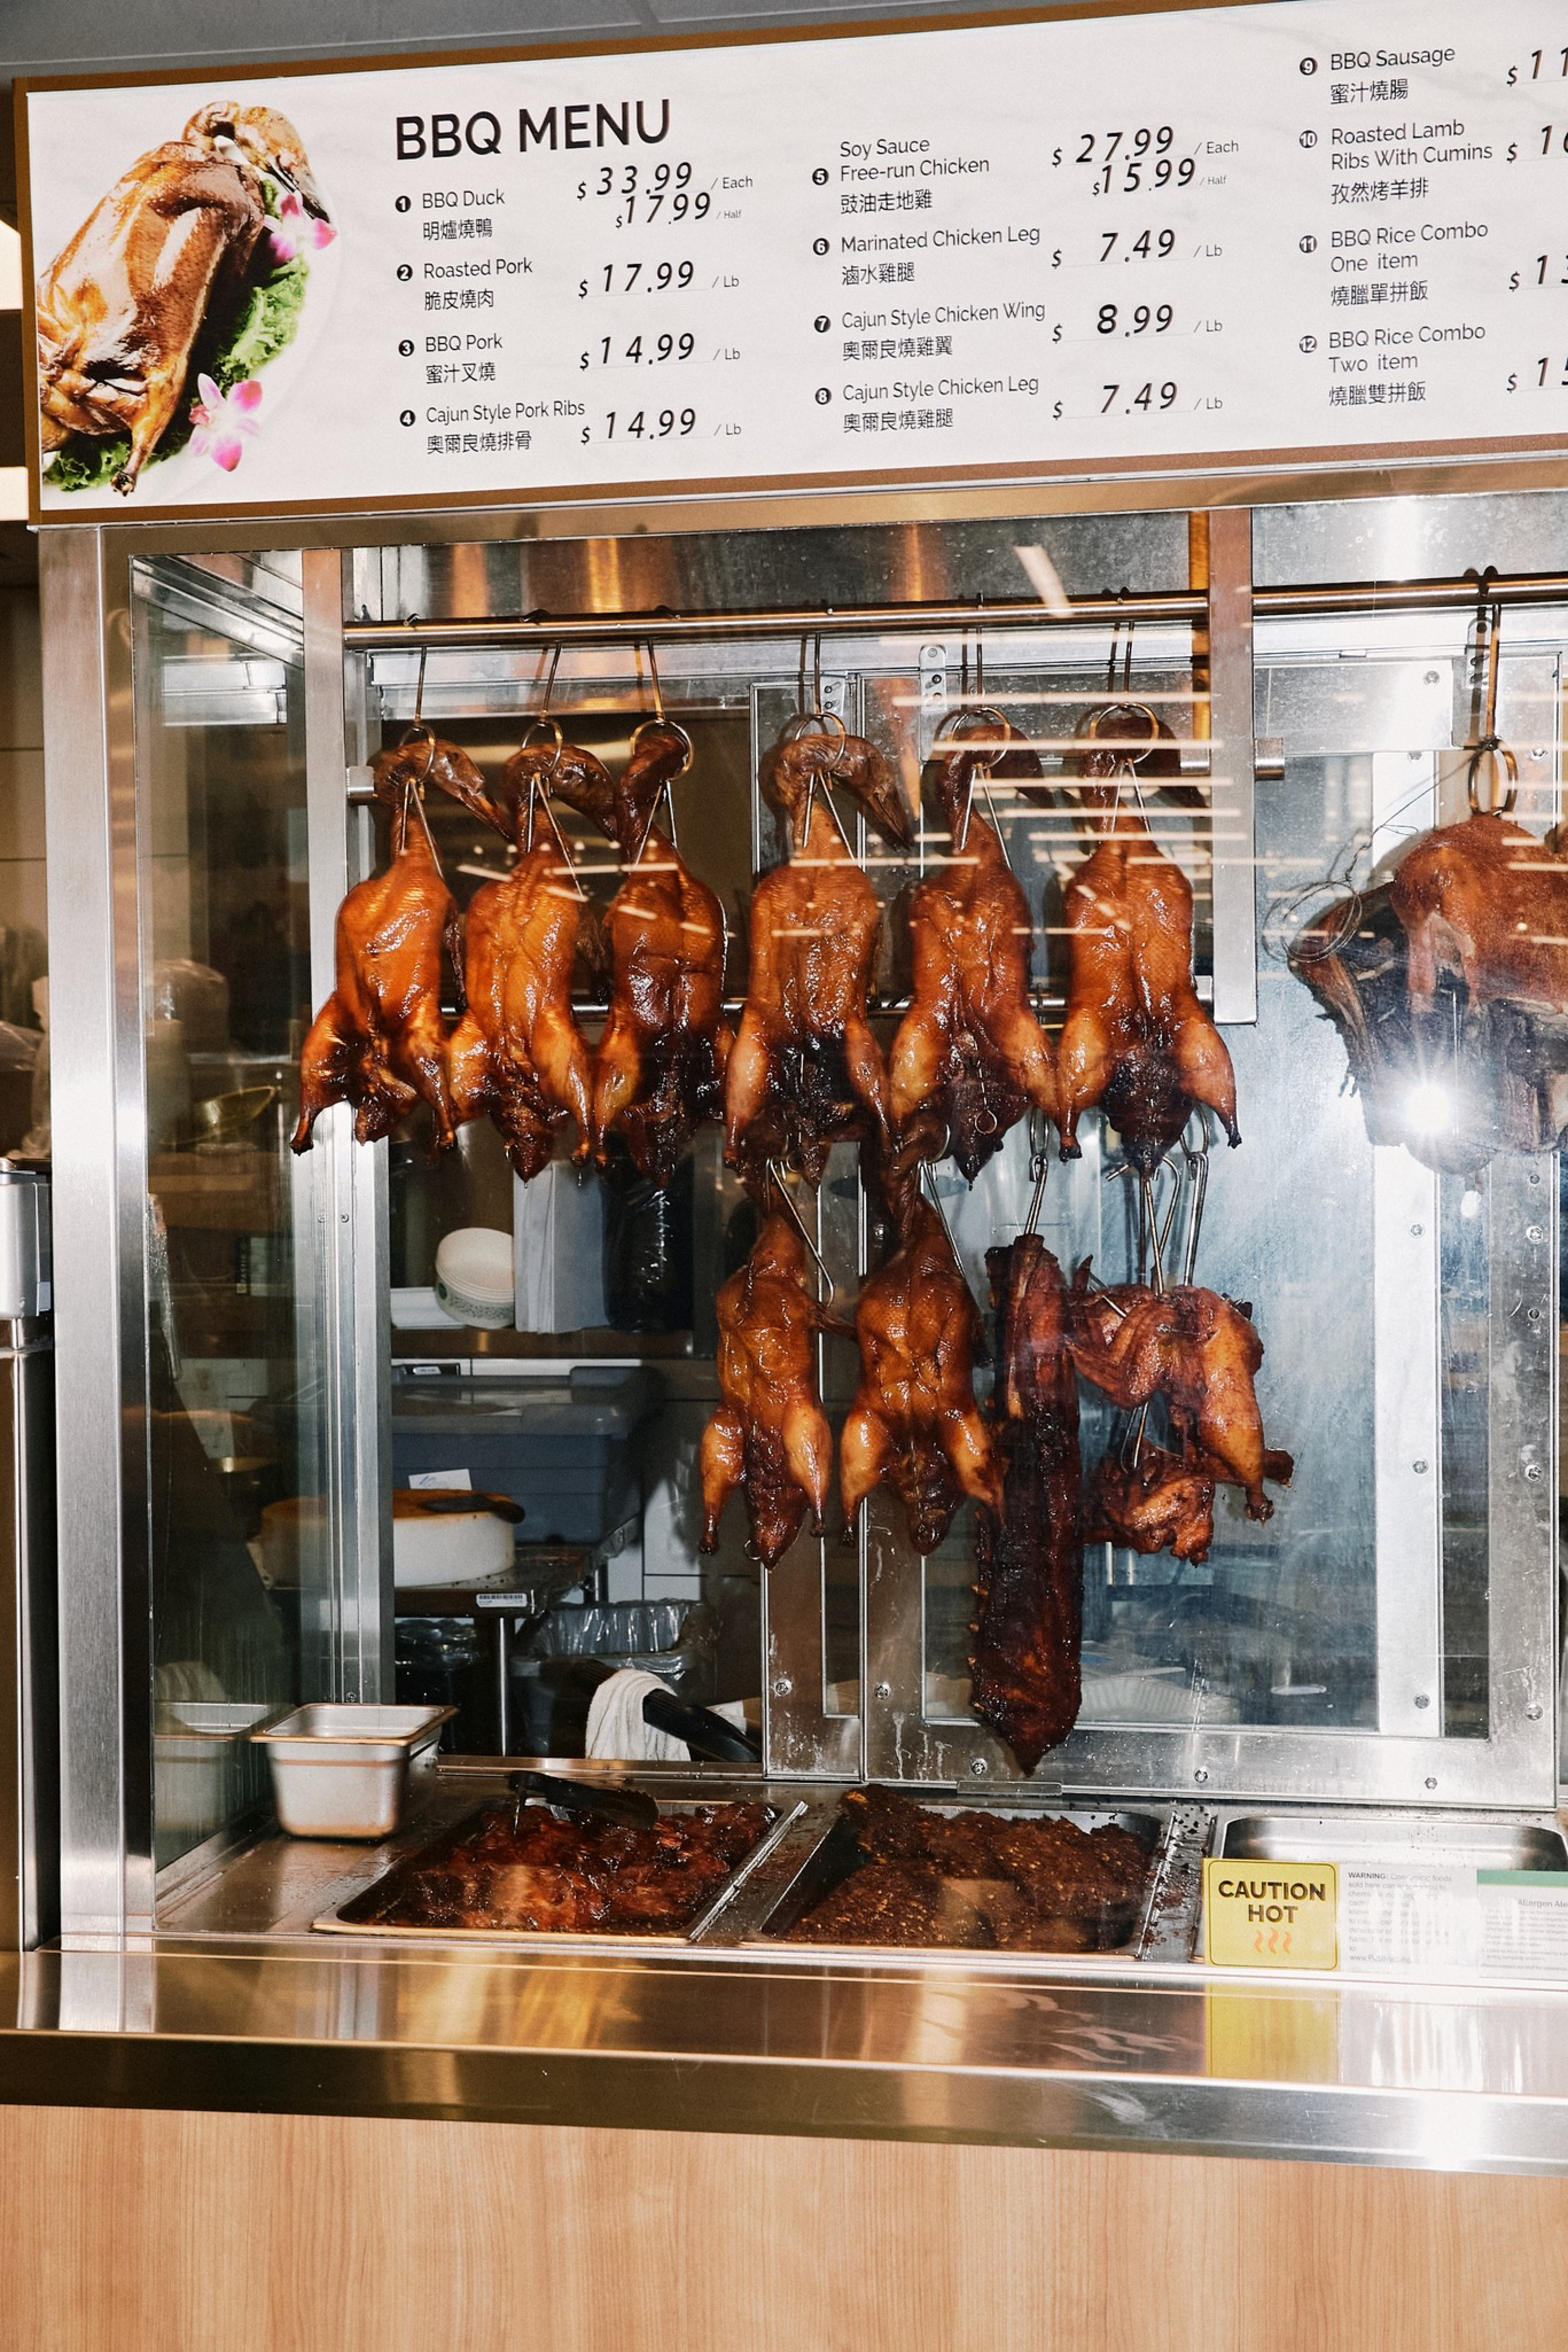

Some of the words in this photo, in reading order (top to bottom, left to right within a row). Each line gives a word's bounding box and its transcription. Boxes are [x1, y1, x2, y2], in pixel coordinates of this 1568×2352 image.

[1331, 51, 1370, 70] BBQ
[1376, 49, 1455, 67] Sausage
[1331, 79, 1408, 105] 蜜汁燒腸
[396, 111, 501, 160] BBQ
[519, 99, 669, 152] MENU
[1332, 123, 1406, 145] Roasted
[1413, 119, 1464, 138] Lamb
[1542, 125, 1568, 154] 1
[840, 141, 871, 161] Soy
[877, 139, 929, 154] Sauce
[1207, 140, 1238, 154] Each
[1332, 153, 1369, 169] Ribs
[1374, 148, 1417, 166] With
[1423, 143, 1492, 163] Cumins
[841, 165, 914, 181] Free-run
[920, 158, 989, 176] Chicken
[1208, 175, 1227, 185] Half
[723, 176, 753, 189] Each
[1332, 177, 1428, 205] 孜然烤羊排
[423, 192, 458, 208] BBQ
[463, 189, 505, 206] Duck
[841, 189, 932, 214] 豉油走地雞
[724, 210, 742, 218] Half
[842, 232, 927, 252] Marinated
[933, 228, 1002, 247] Chicken
[1008, 227, 1039, 245] Leg
[1332, 229, 1371, 247] BBQ
[1377, 227, 1415, 244] Rice
[1421, 221, 1488, 241] Combo
[1206, 245, 1222, 257] Lb
[424, 259, 491, 278] Roasted
[497, 257, 532, 274] Pork
[1331, 256, 1368, 272] One
[1379, 253, 1418, 269] item
[724, 276, 739, 288] Lb
[425, 289, 493, 310] 脆皮燒肉
[842, 311, 886, 331] Cajun
[891, 308, 931, 329] Style
[935, 305, 998, 323] Chicken
[1003, 302, 1045, 321] Wing
[1206, 320, 1223, 332] Lb
[426, 336, 461, 352] BBQ
[467, 333, 502, 350] Pork
[1330, 330, 1368, 348] BBQ
[1375, 328, 1413, 345] Rice
[1419, 323, 1485, 342] Combo
[725, 348, 740, 360] Lb
[843, 336, 952, 361] 奧爾良燒雞翼
[426, 362, 495, 384] 蜜汁叉燒
[1328, 357, 1368, 372] Two
[1379, 354, 1417, 370] item
[843, 384, 888, 404] Cajun
[893, 381, 933, 401] Style
[938, 378, 1003, 395] Chicken
[1009, 376, 1038, 395] Leg
[427, 406, 468, 426] Cajun
[473, 404, 511, 424] Style
[516, 401, 549, 418] Pork
[554, 400, 585, 416] Ribs
[1207, 397, 1223, 410] Lb
[726, 424, 741, 435] Lb
[844, 408, 953, 433] 奧爾良燒雞腿
[428, 430, 531, 454] 奧爾良燒排骨
[1218, 1880, 1325, 1900] CAUTION
[1248, 1904, 1298, 1923] HOT
